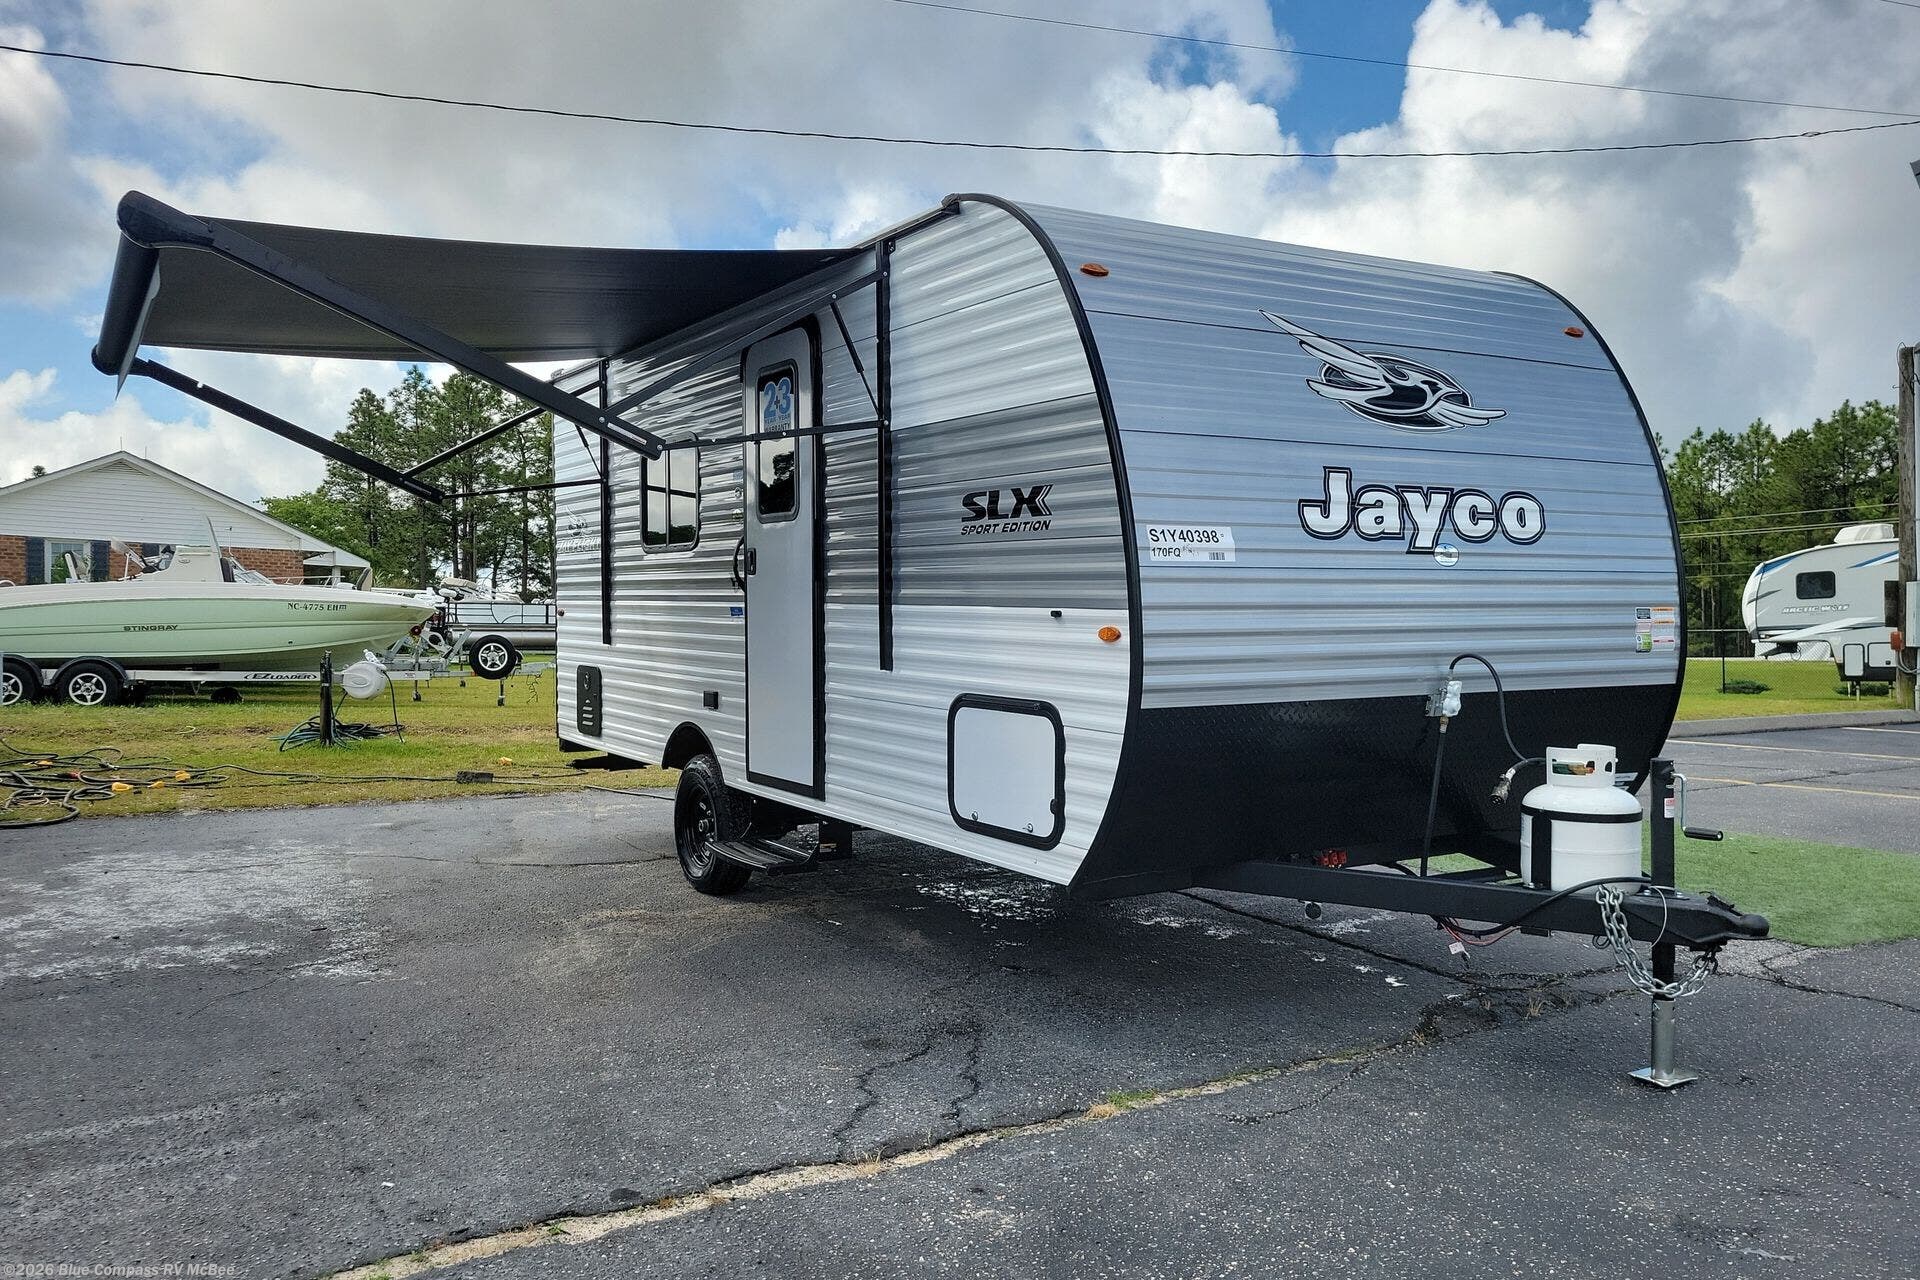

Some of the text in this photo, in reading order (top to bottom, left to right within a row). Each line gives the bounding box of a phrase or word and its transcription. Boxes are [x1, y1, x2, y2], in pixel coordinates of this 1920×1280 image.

[961, 484, 1054, 522] SLX
[1298, 466, 1546, 554] Jayco
[961, 519, 1052, 535] SPORT EDITION
[1149, 528, 1220, 543] S1Y40398
[1151, 547, 1181, 557] 170FQ
[287, 602, 325, 611] NC-4775
[1781, 606, 1819, 614] ARCTIC
[123, 624, 178, 632] STINGRAY
